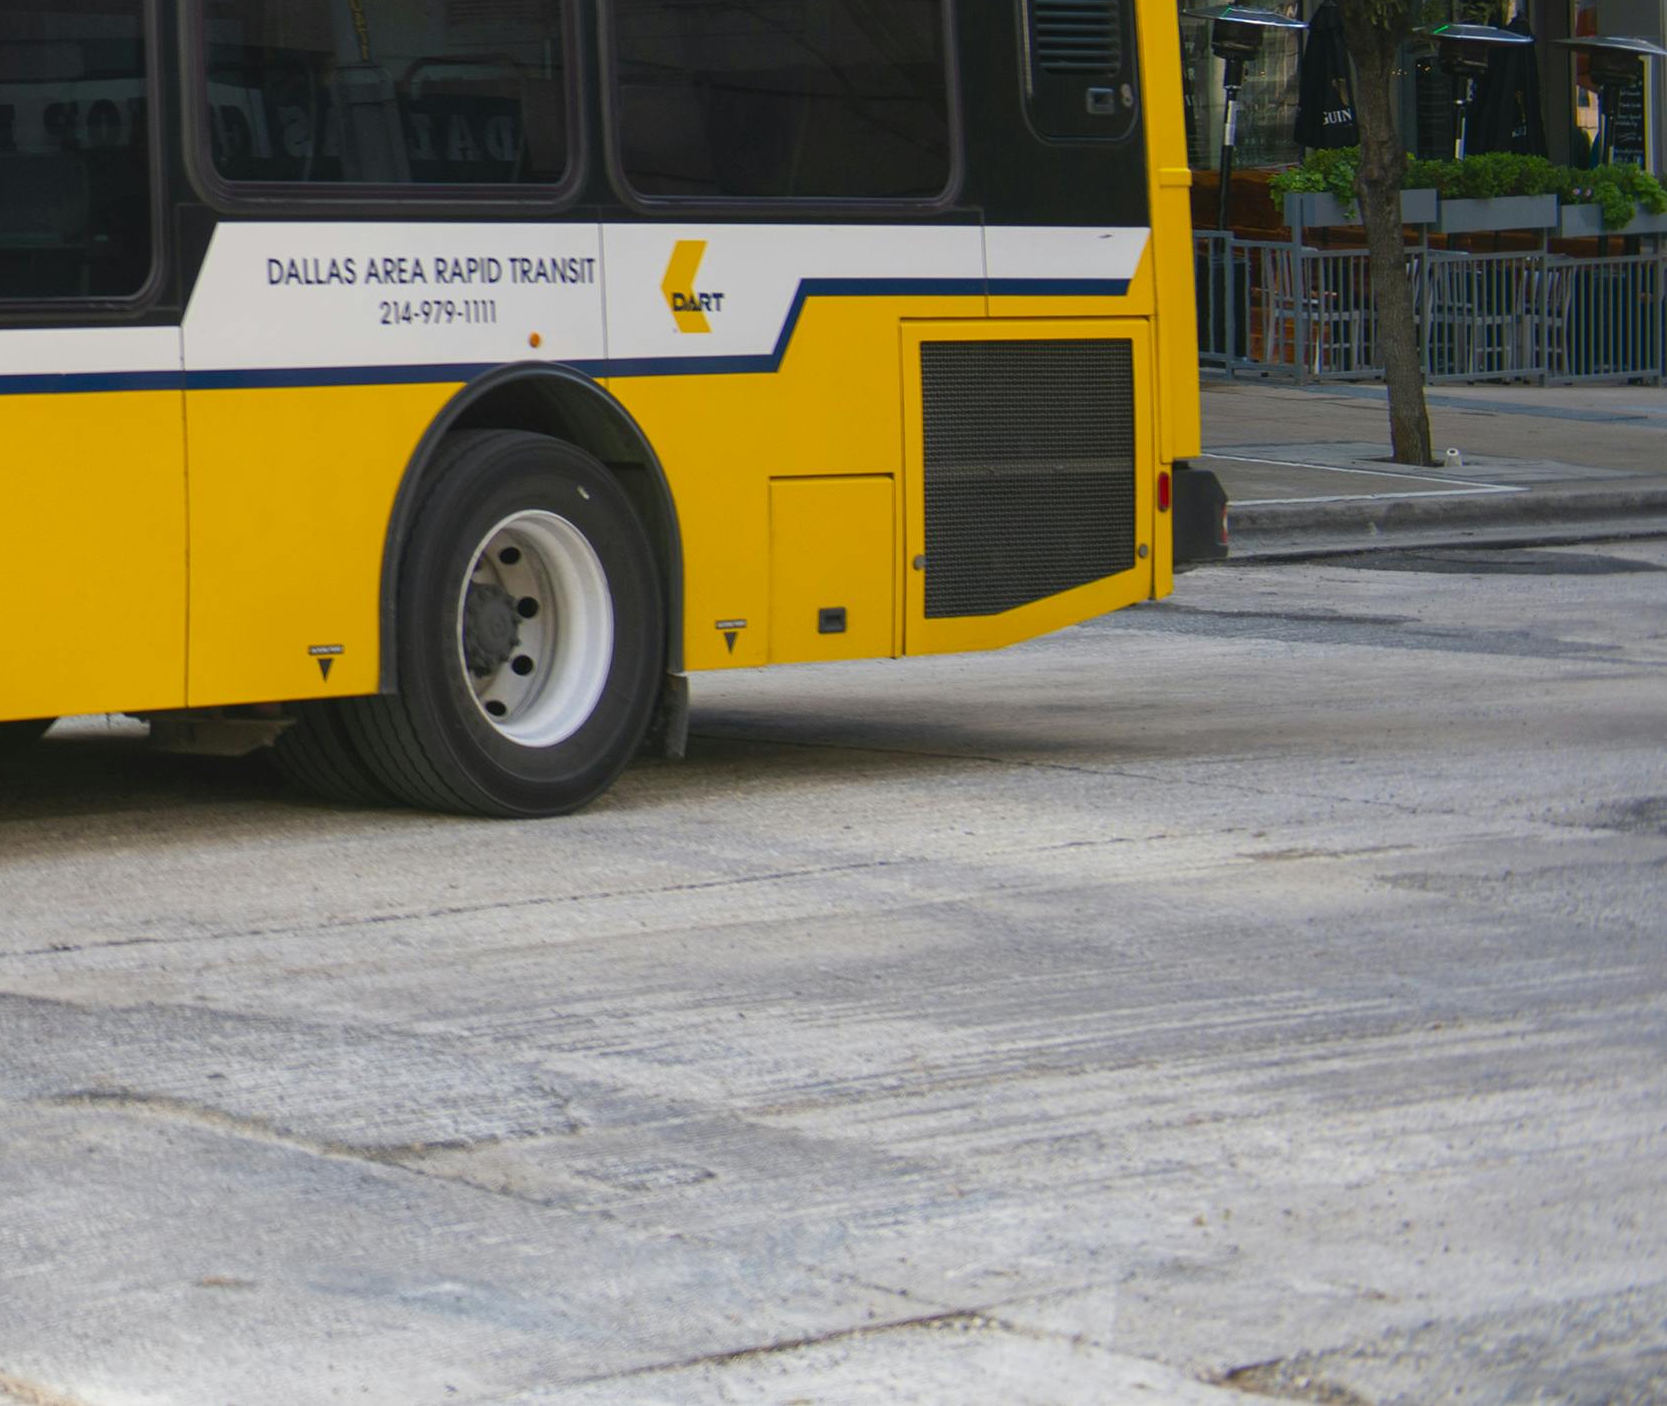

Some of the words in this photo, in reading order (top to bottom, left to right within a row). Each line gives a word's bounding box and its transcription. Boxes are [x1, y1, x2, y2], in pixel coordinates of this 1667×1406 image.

[267, 257, 357, 285] DALLAS
[364, 257, 427, 284] AREA
[434, 257, 503, 284] RAPID
[508, 257, 596, 284] TRANSIT
[378, 299, 498, 325] 214-979-1111
[672, 292, 725, 312] DART
